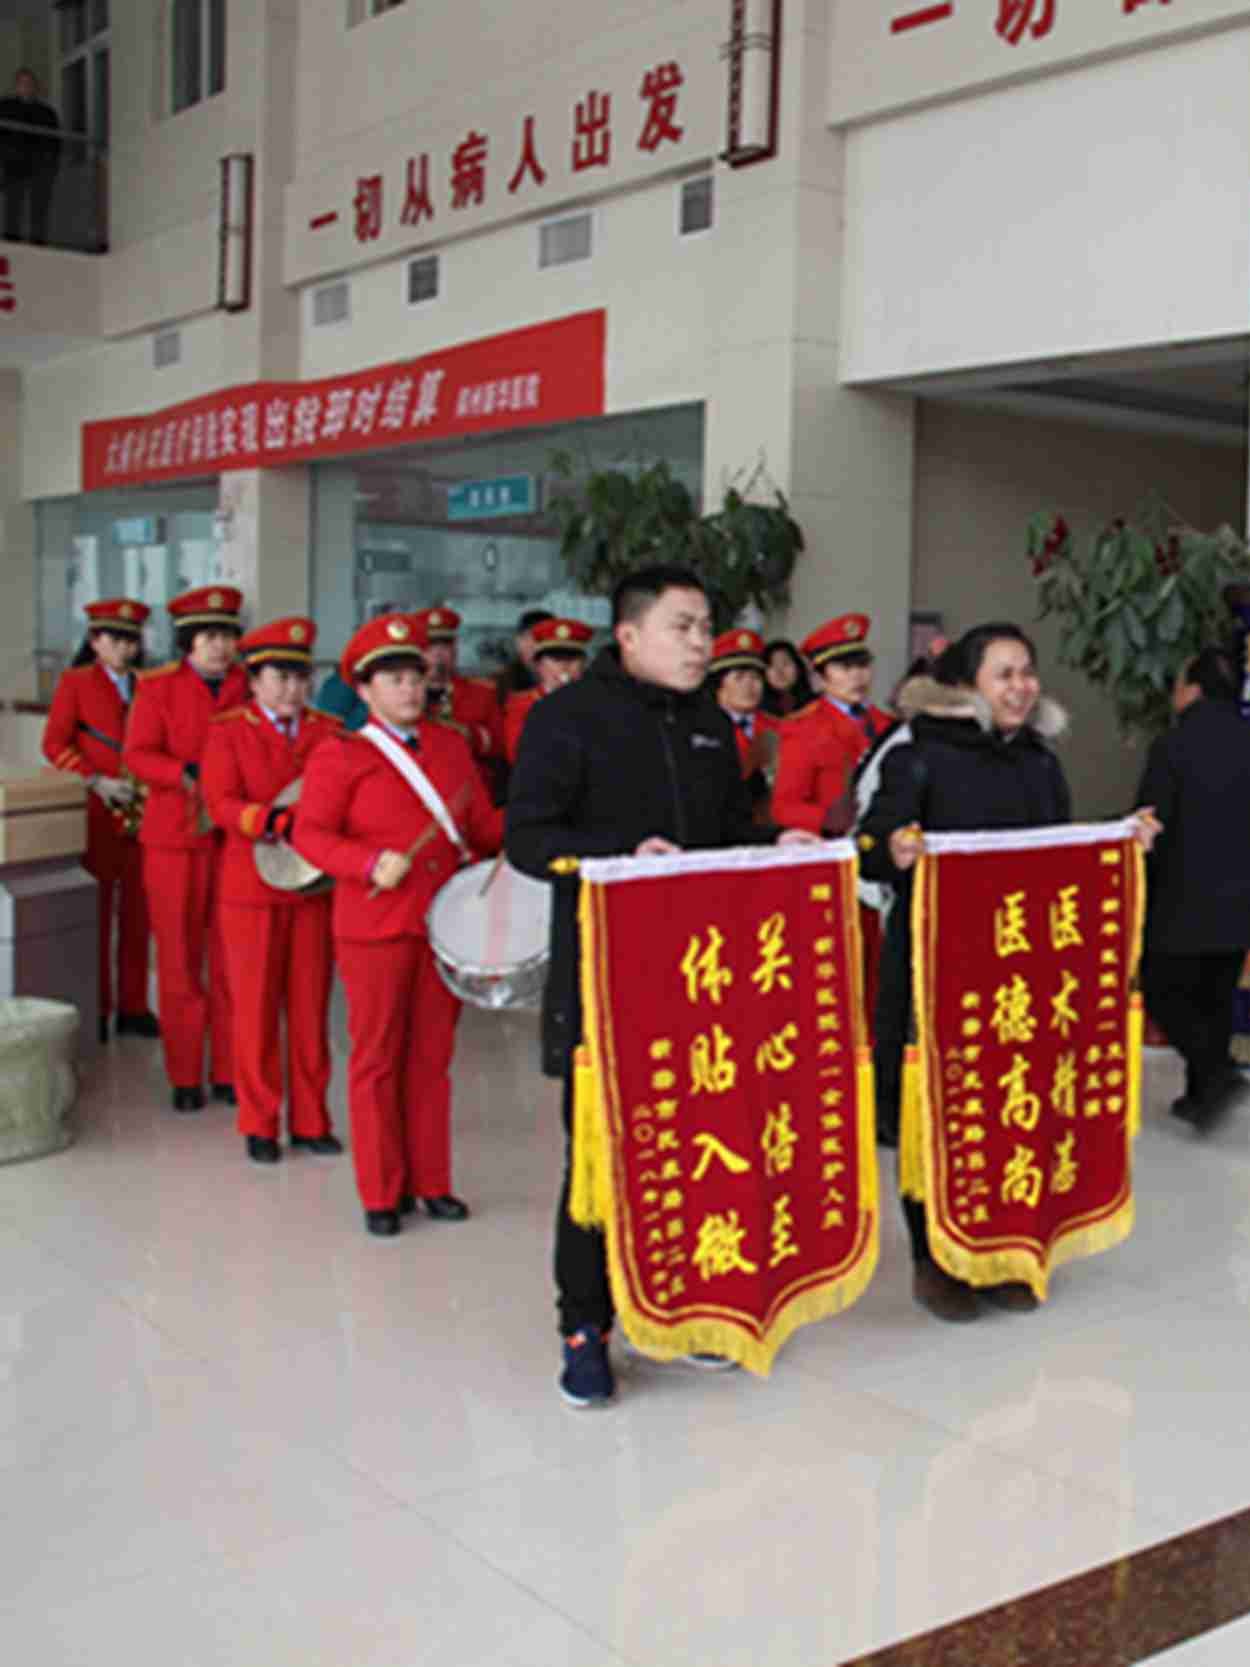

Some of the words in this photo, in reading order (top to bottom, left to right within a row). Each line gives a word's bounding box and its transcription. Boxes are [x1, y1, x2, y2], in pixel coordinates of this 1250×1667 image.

[309, 61, 685, 243] 一切从病人出发
[680, 925, 759, 1281] 体贴入微
[990, 891, 1043, 1208] 医德高尚
